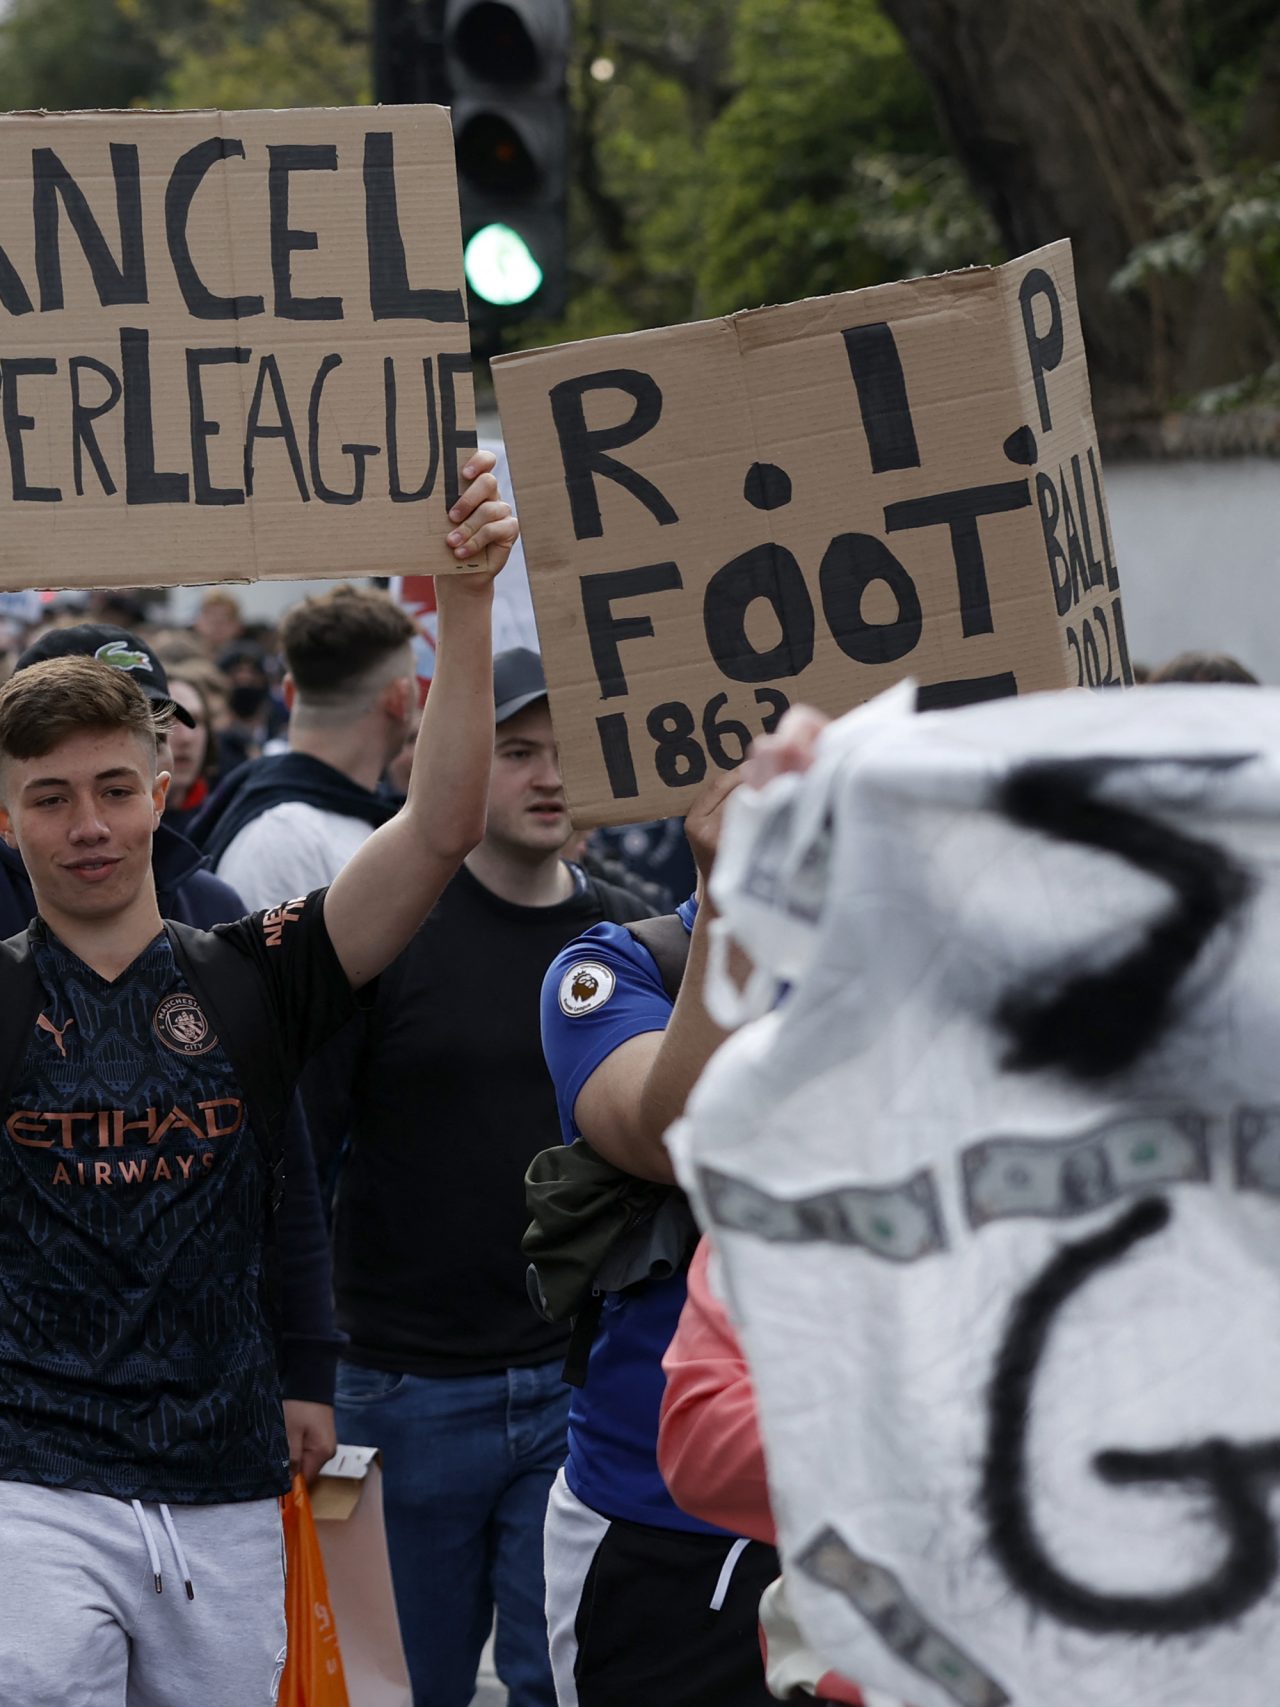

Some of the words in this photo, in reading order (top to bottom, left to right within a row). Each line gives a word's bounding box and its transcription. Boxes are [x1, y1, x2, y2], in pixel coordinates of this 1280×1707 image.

[262, 905, 283, 947] NE
[158, 998, 202, 1020] MANCHEST
[184, 1042, 203, 1051] CITY
[5, 1097, 243, 1149] ETIHAD
[51, 1152, 215, 1186] AIRWAYS
